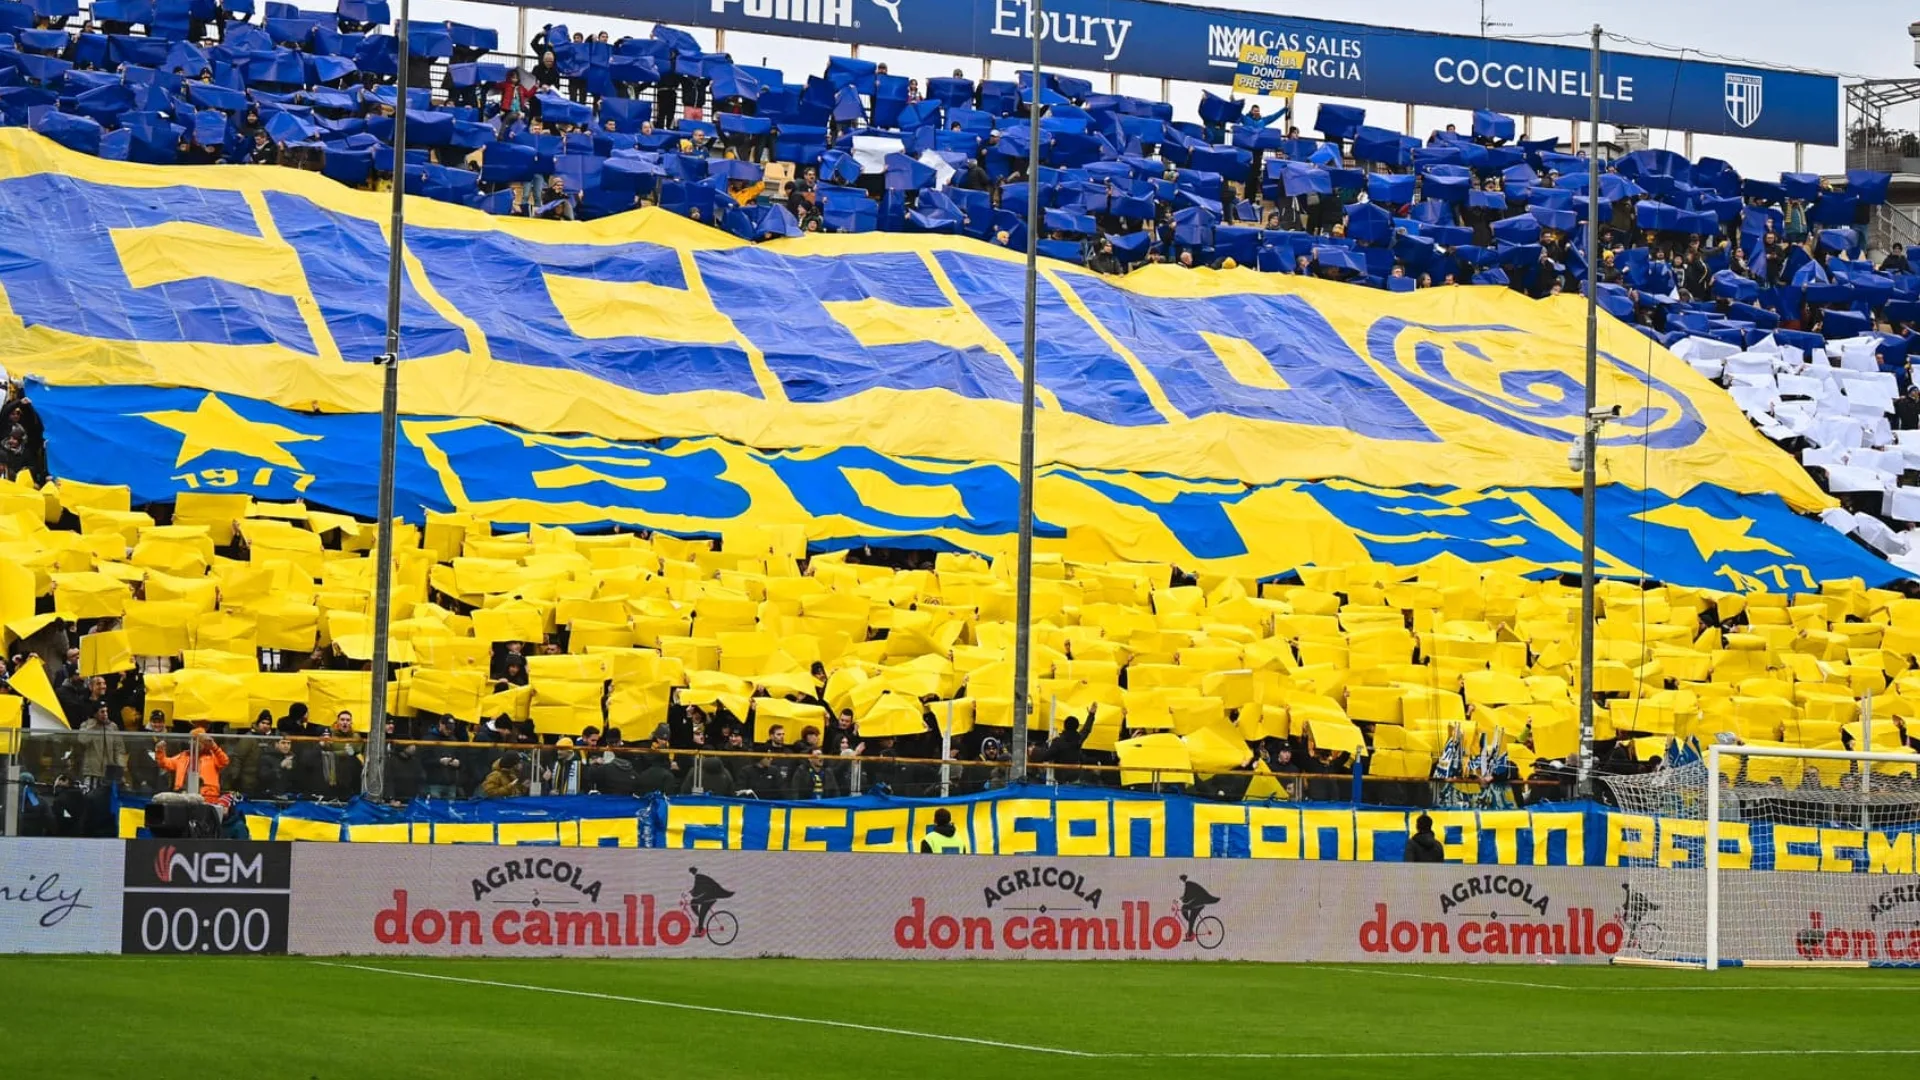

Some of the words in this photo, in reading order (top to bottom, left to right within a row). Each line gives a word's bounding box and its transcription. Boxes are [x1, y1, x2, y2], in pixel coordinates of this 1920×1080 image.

[991, 0, 1132, 60] Ebury
[1259, 30, 1299, 52] GAS
[1306, 35, 1362, 59] SALES
[1246, 52, 1296, 67] FAMIGLIA
[1252, 66, 1286, 79] DONDI
[1301, 58, 1362, 81] RGIA
[1434, 56, 1633, 102] COCCINELLE
[1238, 77, 1293, 92] PRESENTE
[169, 852, 263, 884] NGM
[471, 858, 602, 902] AGRICOLA
[983, 867, 1103, 909] AGRICOLA
[1439, 875, 1550, 916] AGRICOLA
[141, 907, 270, 951] 00:00
[373, 890, 483, 945] don
[493, 894, 691, 946] camillo
[894, 897, 994, 950] don
[1003, 901, 1181, 950] camillo
[1359, 903, 1449, 953] don
[1458, 908, 1623, 954] camillo
